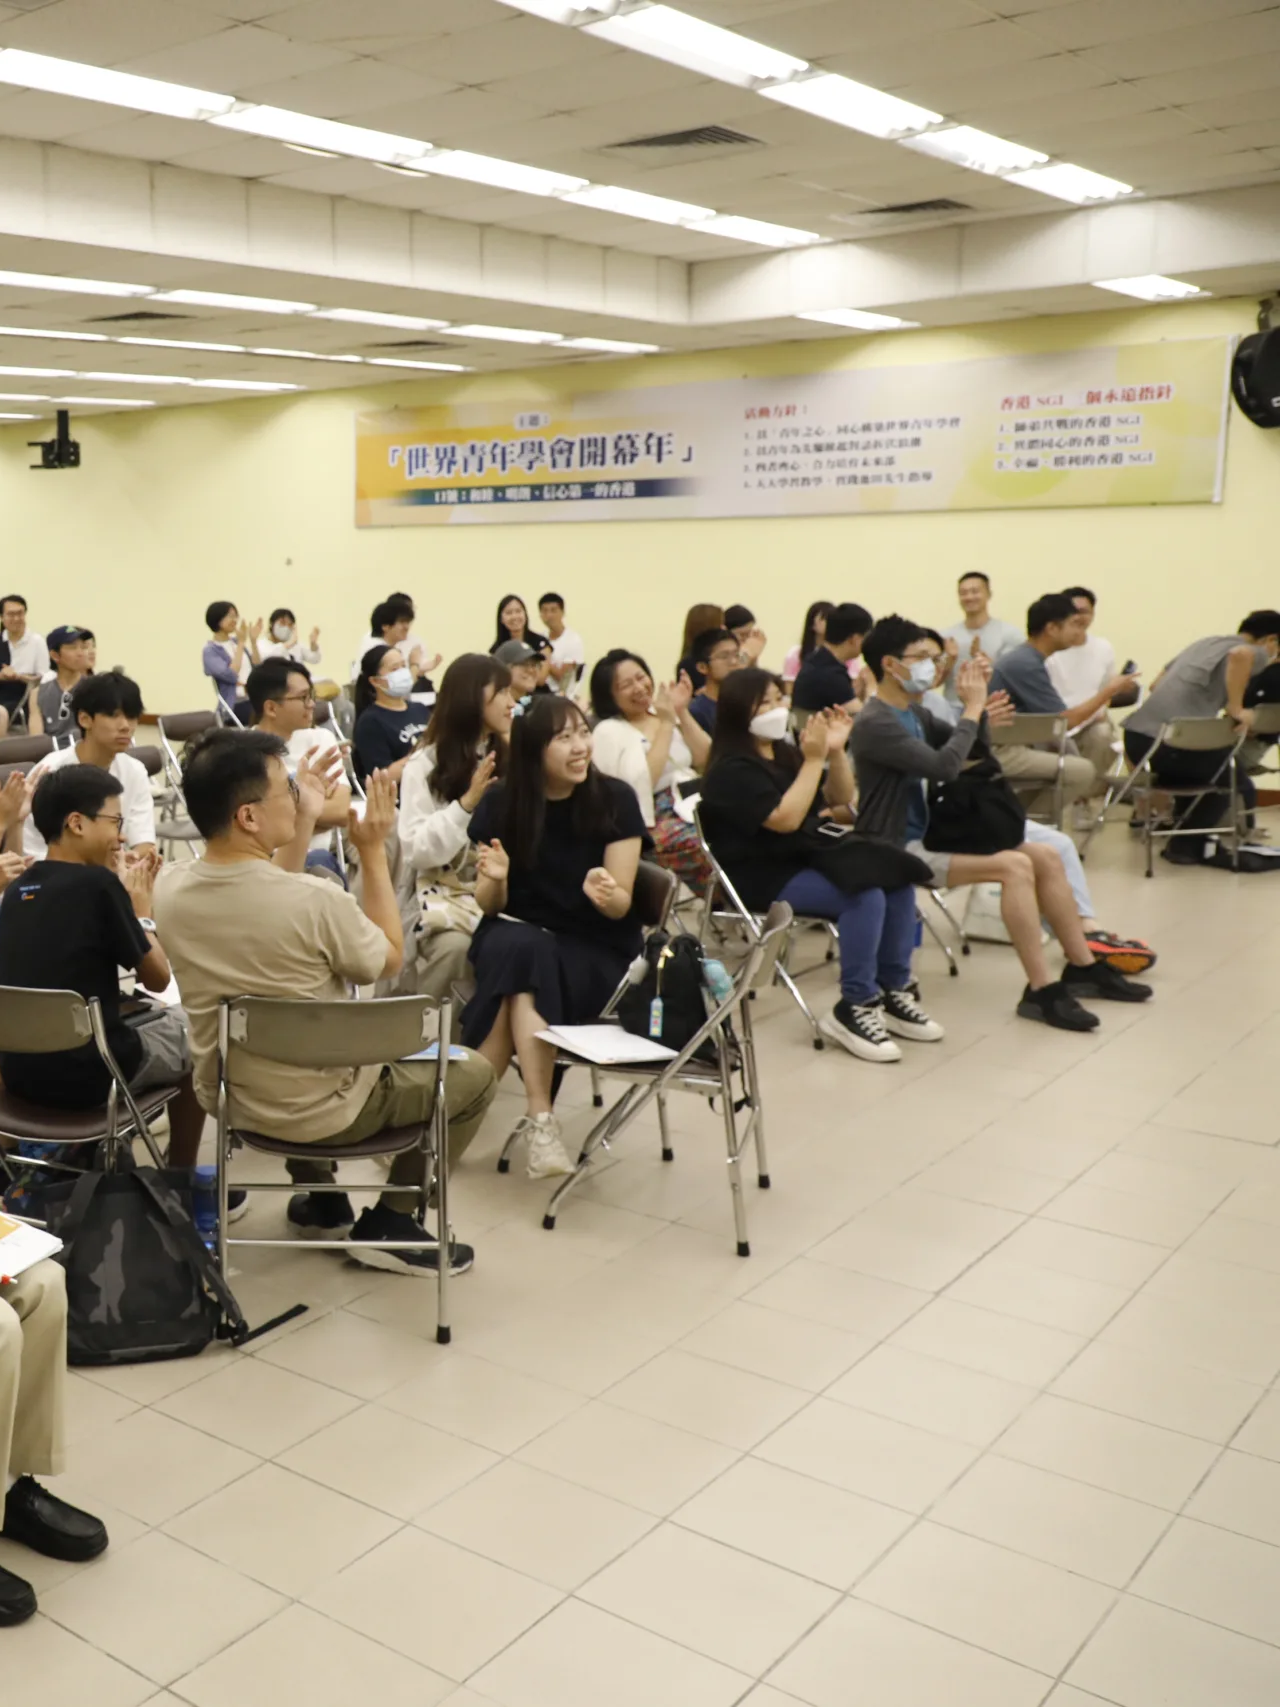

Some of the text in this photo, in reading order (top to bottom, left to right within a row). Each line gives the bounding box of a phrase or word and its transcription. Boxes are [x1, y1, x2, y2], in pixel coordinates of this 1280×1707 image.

[389, 432, 694, 477] 「世界青年學會開幕年」
